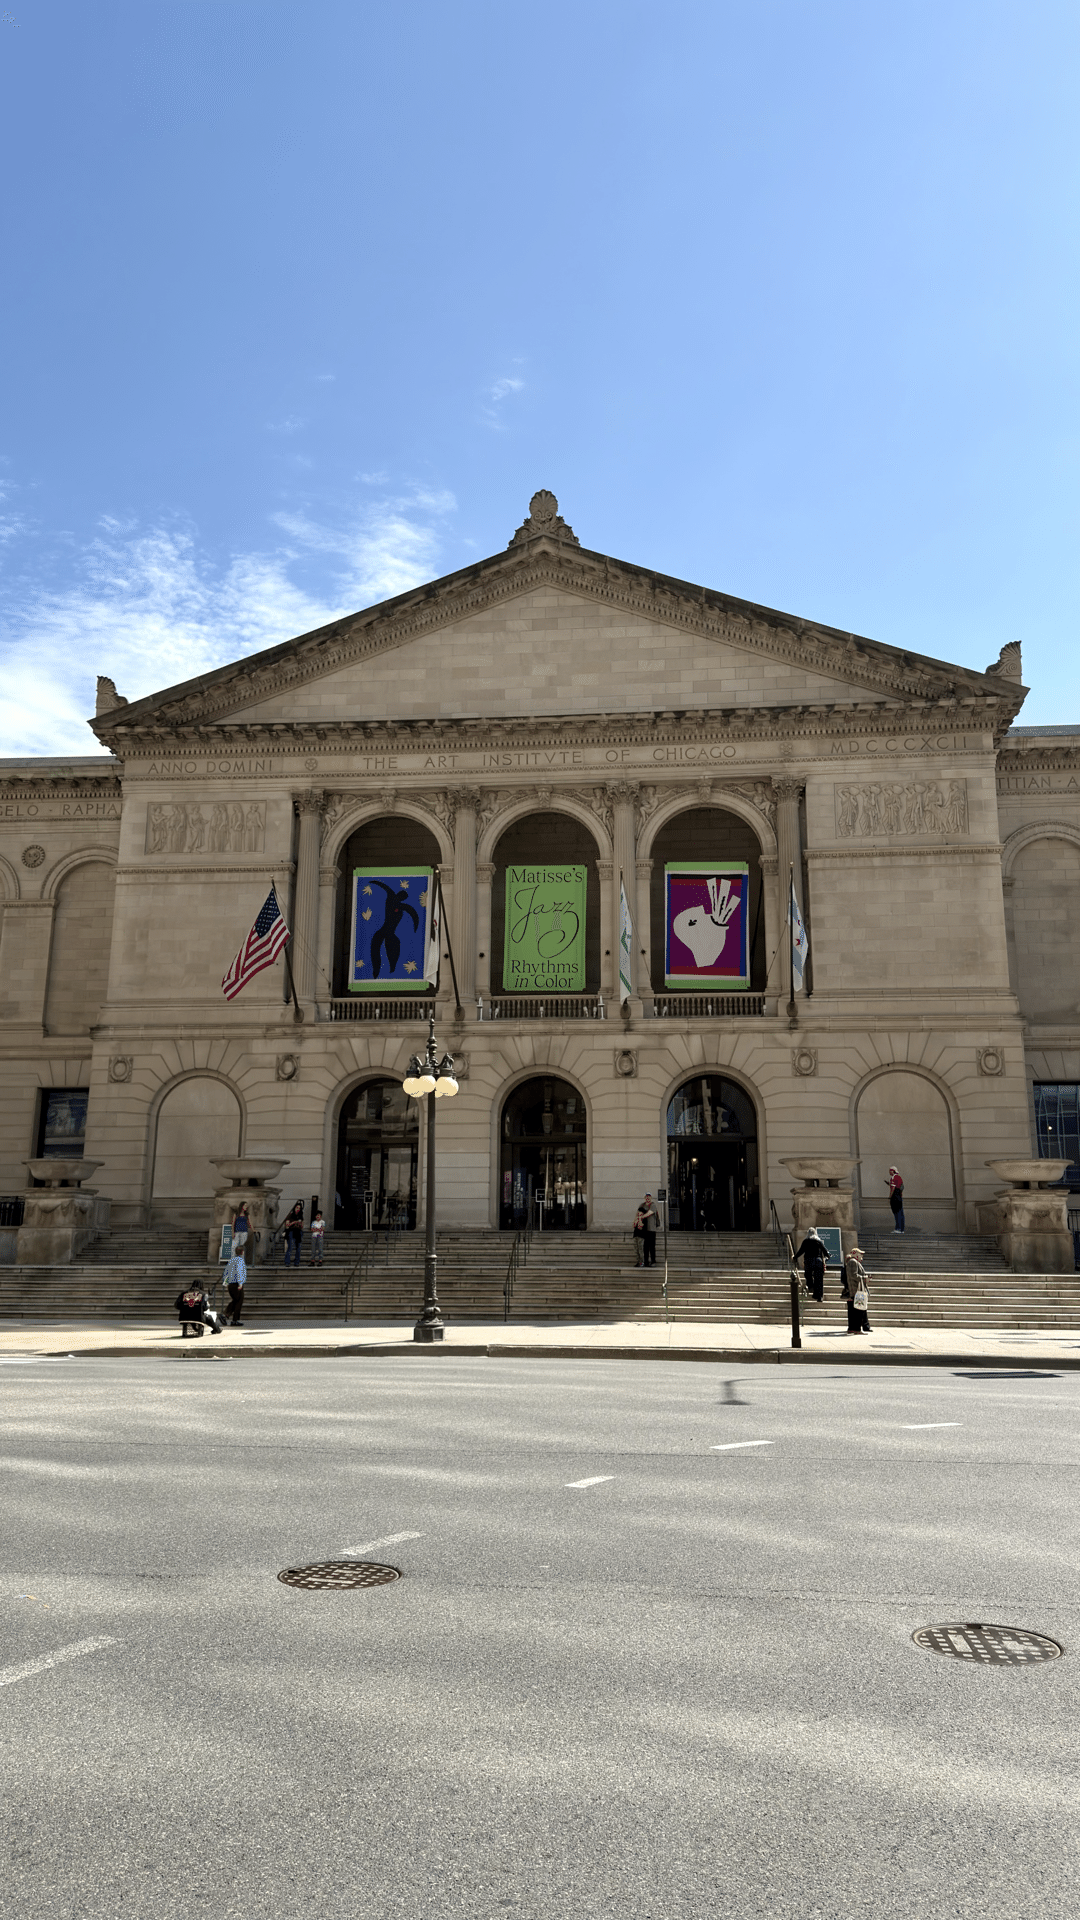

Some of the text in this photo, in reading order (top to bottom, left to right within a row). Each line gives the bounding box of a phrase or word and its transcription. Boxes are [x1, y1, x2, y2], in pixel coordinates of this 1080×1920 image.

[831, 735, 968, 754] MDCCCXCII
[363, 756, 398, 770] THE
[424, 755, 460, 768] ART
[606, 749, 631, 763] OF
[653, 745, 737, 761] CHICAGO
[148, 759, 273, 775] ANNO DOMINI
[995, 776, 1051, 790] TITIAN
[0, 804, 39, 817] ELO
[511, 867, 583, 884] Matisse's
[510, 884, 580, 959] Jazz
[511, 959, 579, 977] Rhythms
[514, 974, 574, 989] in Color
